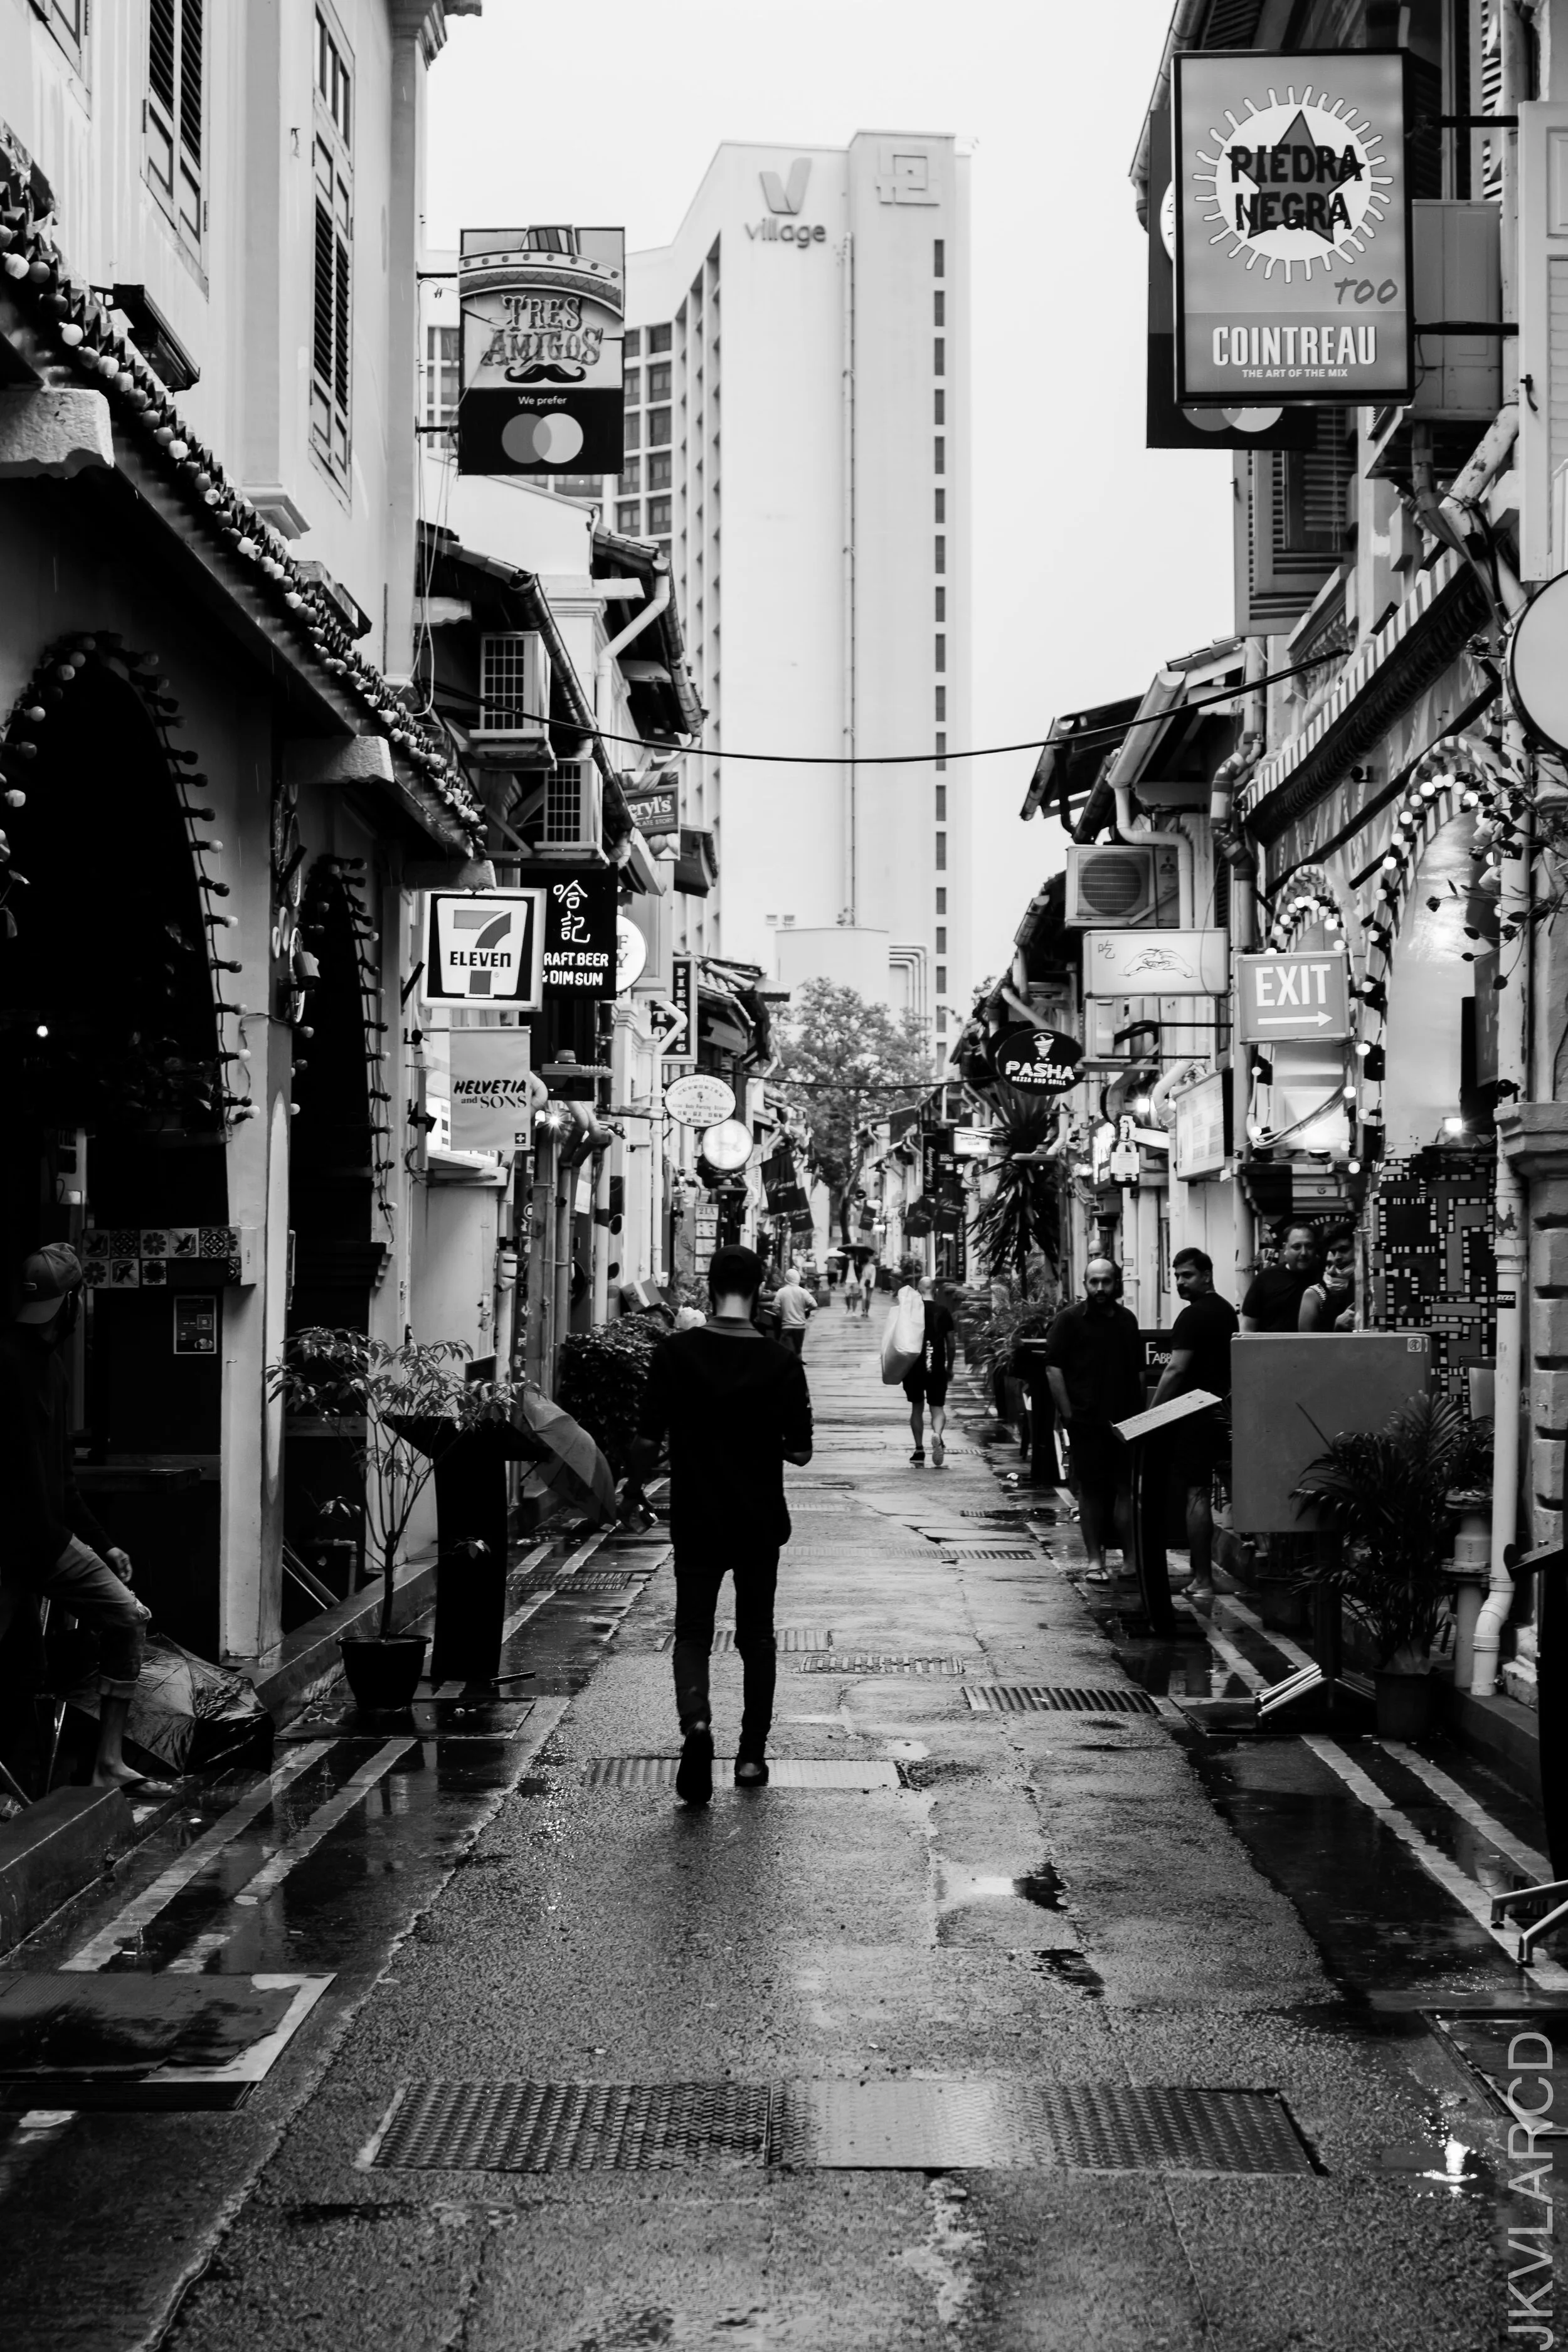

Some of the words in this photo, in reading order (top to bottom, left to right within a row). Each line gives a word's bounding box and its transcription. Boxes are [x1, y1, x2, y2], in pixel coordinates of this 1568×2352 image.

[1231, 144, 1364, 184] PIEDRA
[1236, 192, 1353, 231] NEGRA
[744, 217, 826, 248] village
[1335, 277, 1399, 305] TOO
[501, 294, 582, 331] TRES
[480, 327, 604, 368] AMIGOS
[1212, 326, 1377, 366] COINTREAU
[1242, 369, 1263, 378] THE
[1266, 369, 1286, 377] ART
[1288, 369, 1303, 377] OF
[1304, 369, 1325, 377] THE
[1328, 369, 1348, 377] MIX
[518, 396, 534, 405] We
[537, 395, 567, 406] prefer
[627, 796, 671, 819] eryl's
[544, 952, 576, 966] RAFT
[576, 953, 609, 967] BEER
[550, 970, 574, 985] DIM
[575, 972, 603, 985] SUM
[1255, 964, 1331, 1007] EXIT
[675, 968, 687, 1052] PIERNG
[1005, 1061, 1075, 1080] PASHA
[453, 1079, 526, 1095] HELVETIA
[461, 1096, 477, 1105] and
[480, 1095, 527, 1109] SONS
